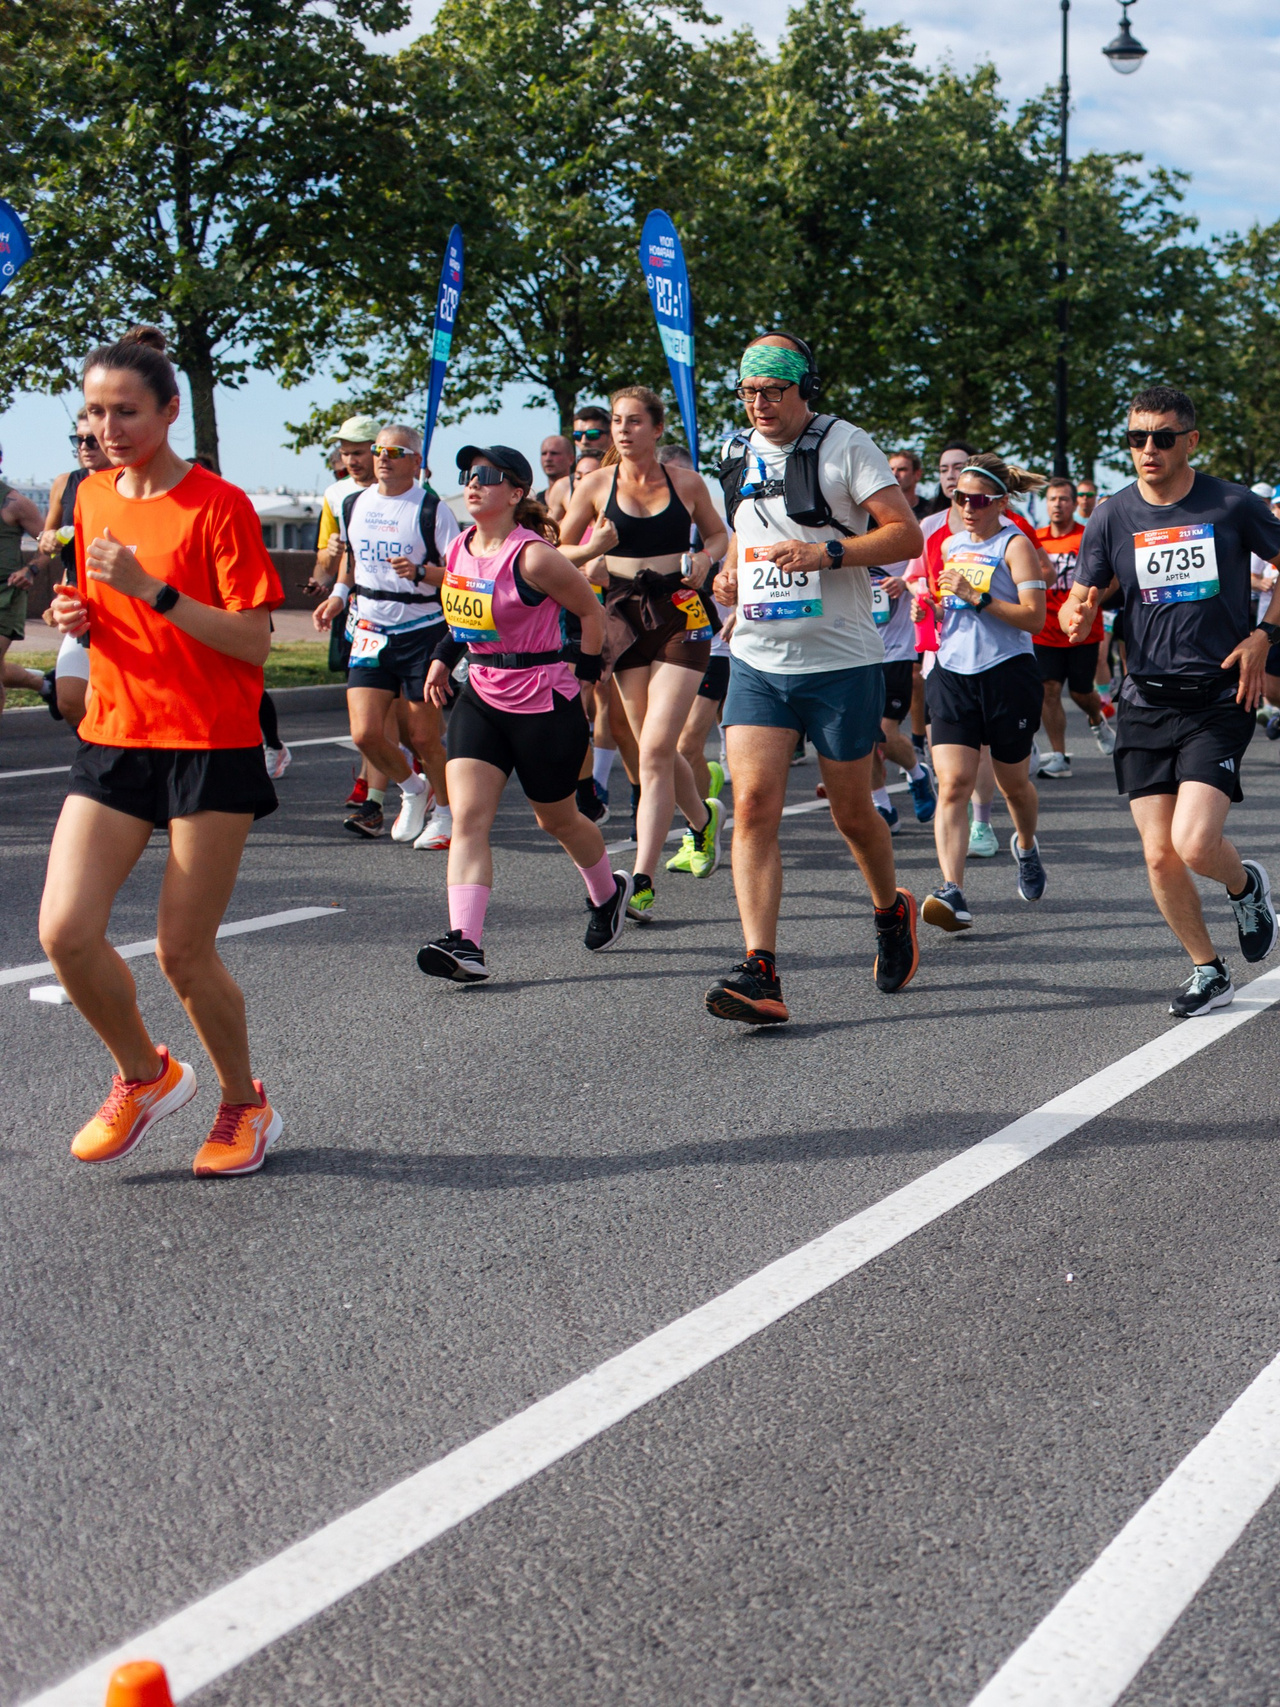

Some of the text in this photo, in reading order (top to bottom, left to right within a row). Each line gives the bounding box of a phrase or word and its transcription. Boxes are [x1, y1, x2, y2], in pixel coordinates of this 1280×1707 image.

[360, 539, 402, 562] 2:09
[1147, 545, 1206, 575] 6735
[753, 566, 809, 590] 2403
[1165, 573, 1190, 582] АРТЁМ
[446, 592, 484, 619] 6460
[1149, 589, 1160, 603] E
